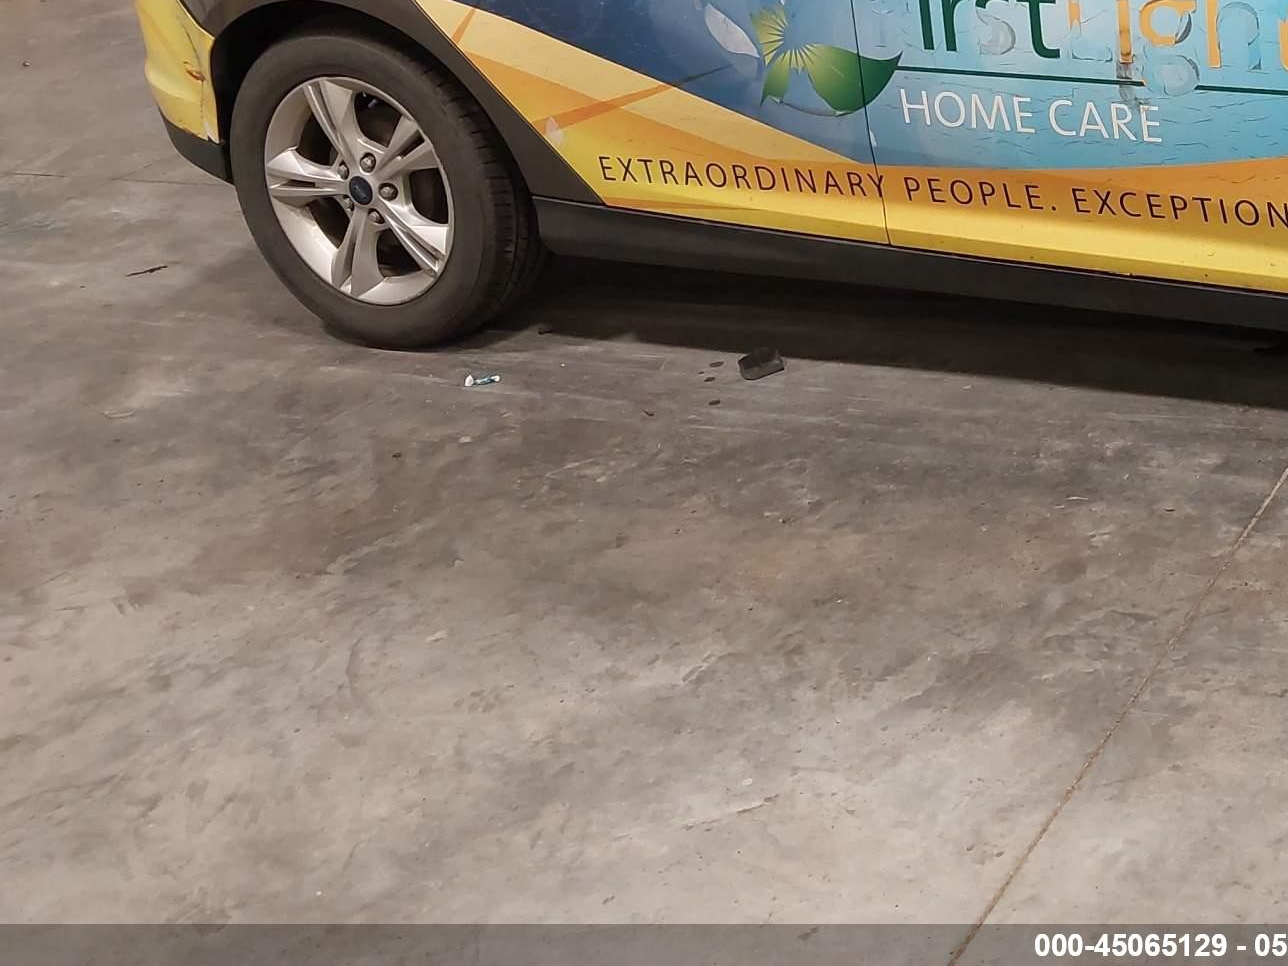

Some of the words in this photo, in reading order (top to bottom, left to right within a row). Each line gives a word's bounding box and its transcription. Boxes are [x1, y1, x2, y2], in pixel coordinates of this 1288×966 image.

[899, 88, 1035, 135] HOME
[1047, 99, 1163, 144] CARE
[598, 156, 884, 199] EXTRAORDINARY
[903, 176, 1057, 212] PEOPLE.
